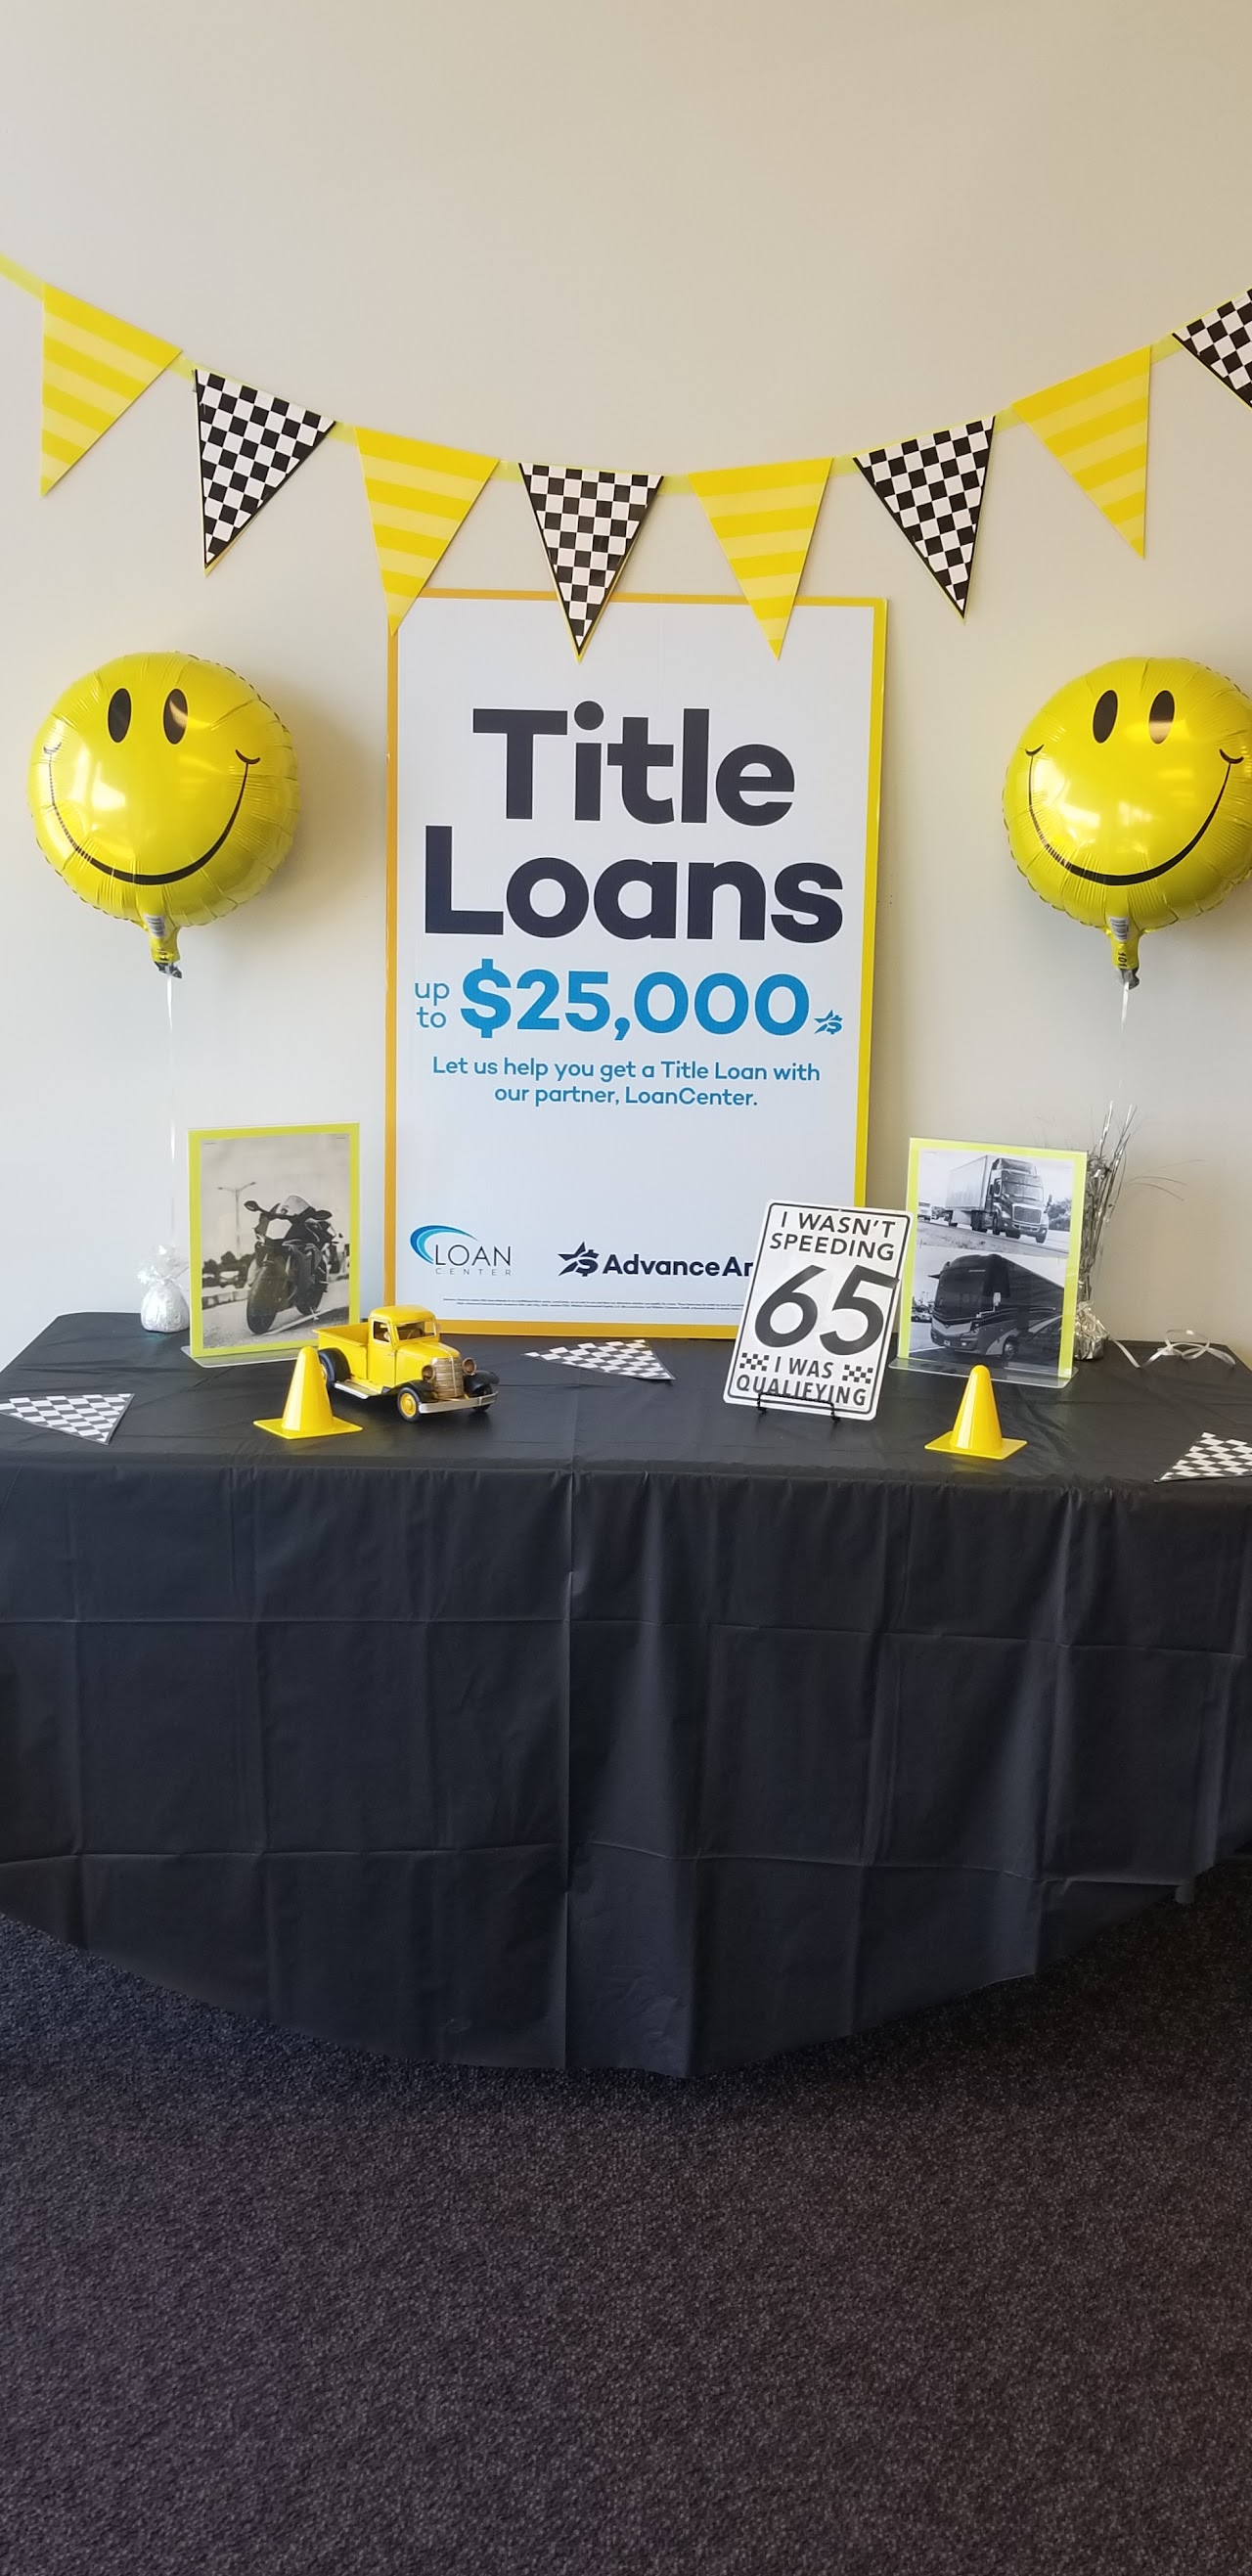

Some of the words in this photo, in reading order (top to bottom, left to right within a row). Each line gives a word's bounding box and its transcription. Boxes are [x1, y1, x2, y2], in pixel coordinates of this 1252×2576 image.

[472, 700, 795, 827] Title
[425, 825, 844, 944] Loans
[414, 981, 451, 1005] up
[460, 958, 810, 1042] $25,000
[416, 1006, 447, 1029] to
[432, 1056, 469, 1075] Let
[473, 1062, 499, 1075] us
[504, 1057, 549, 1082] help
[554, 1062, 595, 1082] you
[600, 1061, 637, 1083] get
[641, 1064, 655, 1079] a
[660, 1060, 709, 1080] Title
[714, 1062, 768, 1081] Loan
[772, 1062, 821, 1081] with
[494, 1088, 530, 1102] our
[535, 1085, 620, 1107] partner,
[625, 1085, 758, 1107] LoanCenter.
[781, 1211, 788, 1228] I
[798, 1212, 896, 1239] WASN'T
[435, 1243, 512, 1267] LOAN
[769, 1232, 895, 1261] SPEEDING
[435, 1267, 512, 1276] CENTER
[754, 1264, 900, 1356] 65
[775, 1356, 782, 1374] I
[788, 1357, 834, 1379] WAS
[736, 1374, 867, 1407] QUALIFYING
